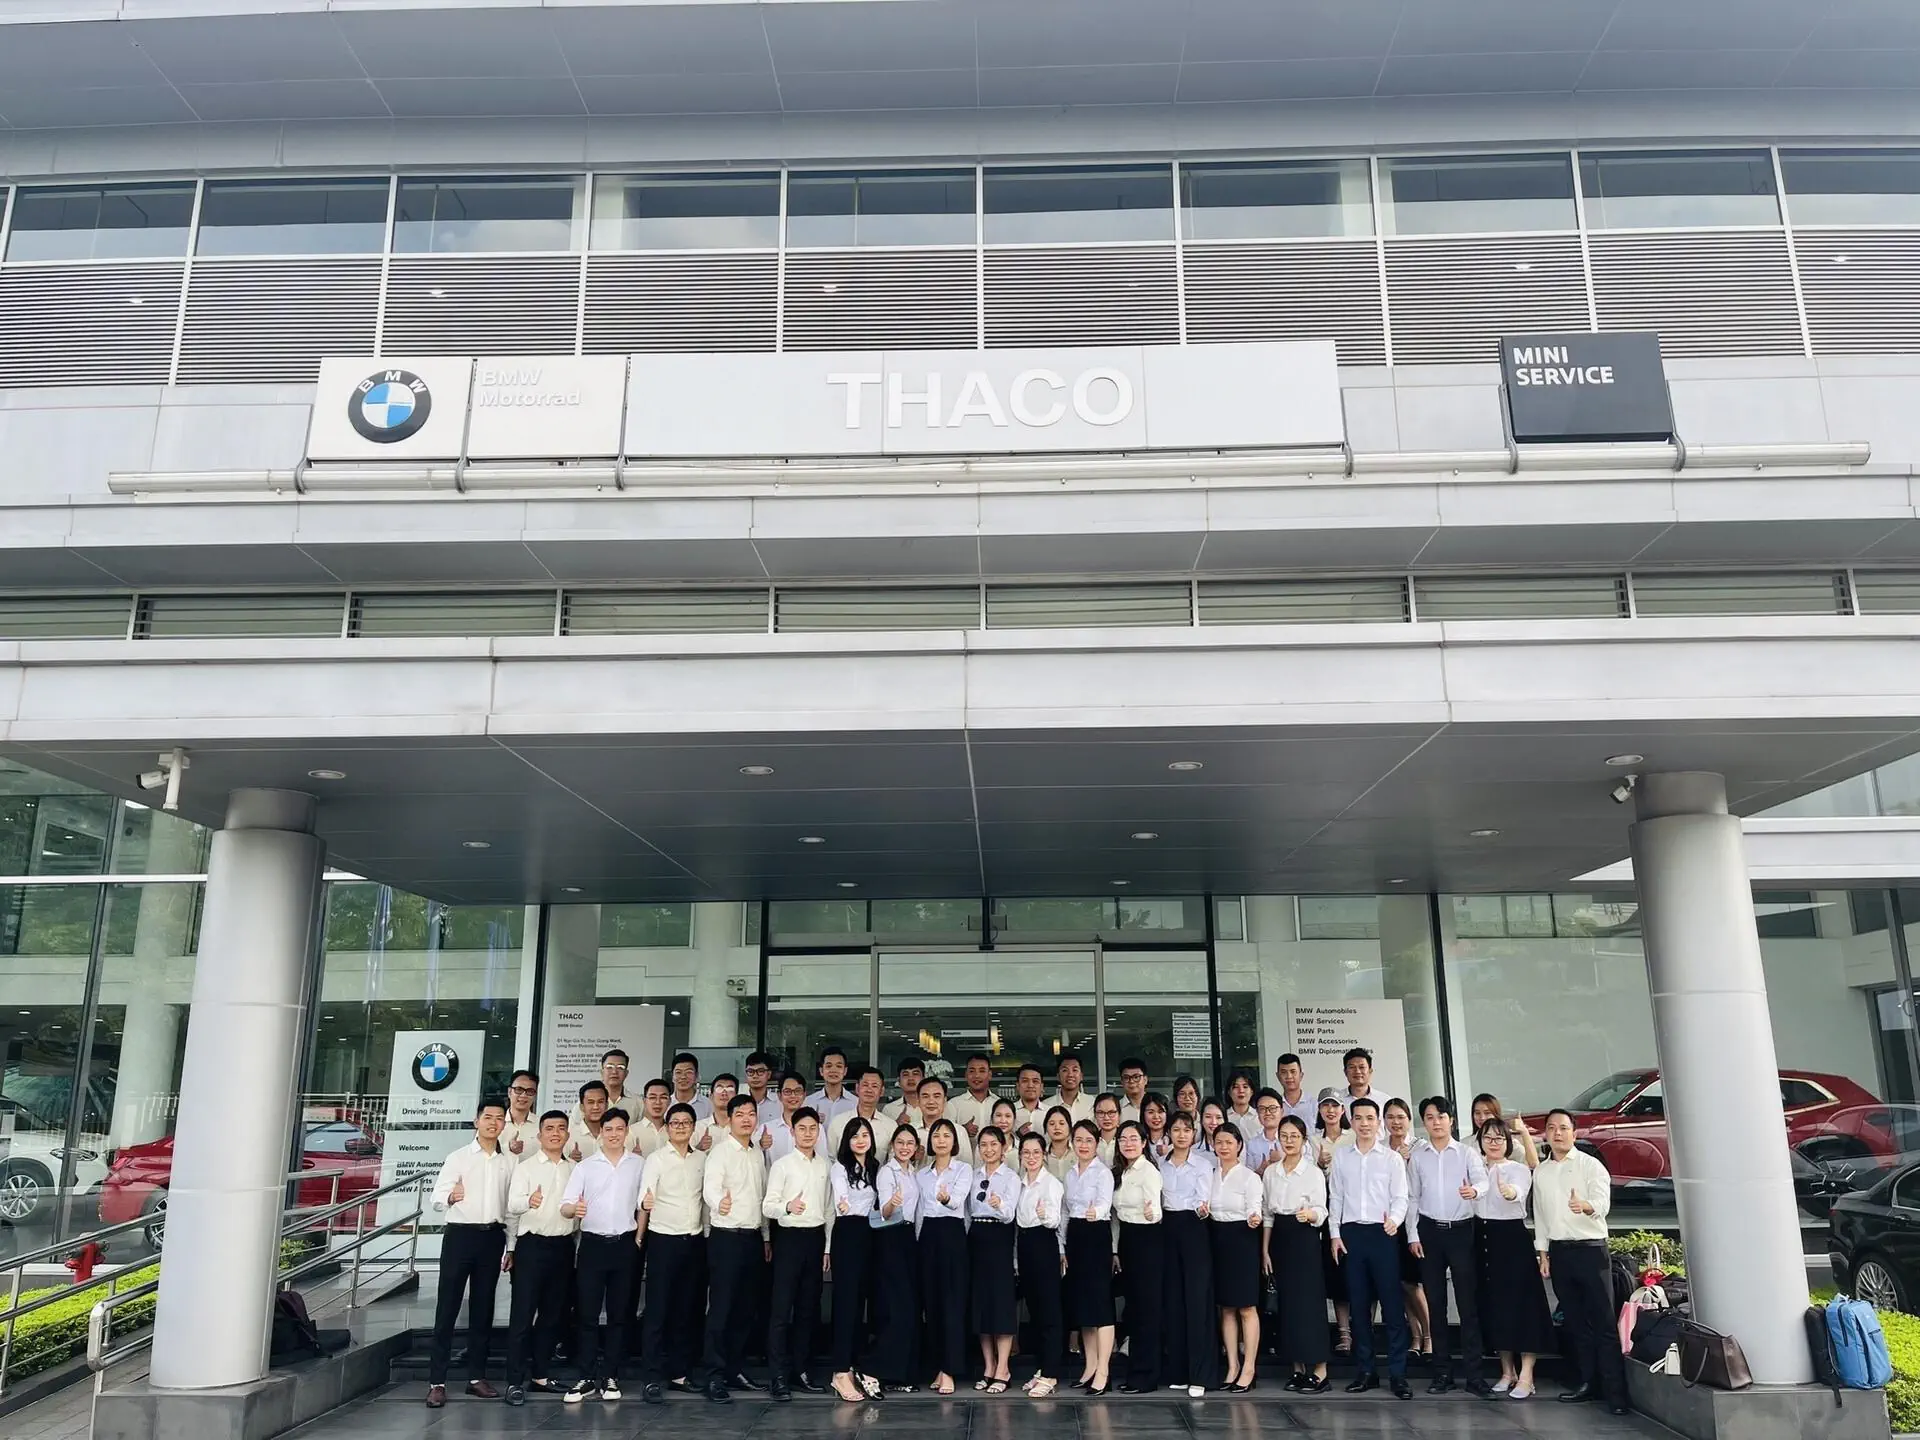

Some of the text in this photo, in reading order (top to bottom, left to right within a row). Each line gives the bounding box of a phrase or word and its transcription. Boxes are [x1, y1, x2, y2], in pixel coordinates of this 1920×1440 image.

[1513, 346, 1569, 365] MINI
[358, 370, 427, 393] BMW
[480, 368, 543, 387] BMW
[1515, 366, 1615, 386] SERVICE
[480, 388, 583, 407] Motorrad
[826, 366, 1135, 429] THACO
[416, 1043, 456, 1060] BMW
[402, 1107, 461, 1116] Driving Pleasure
